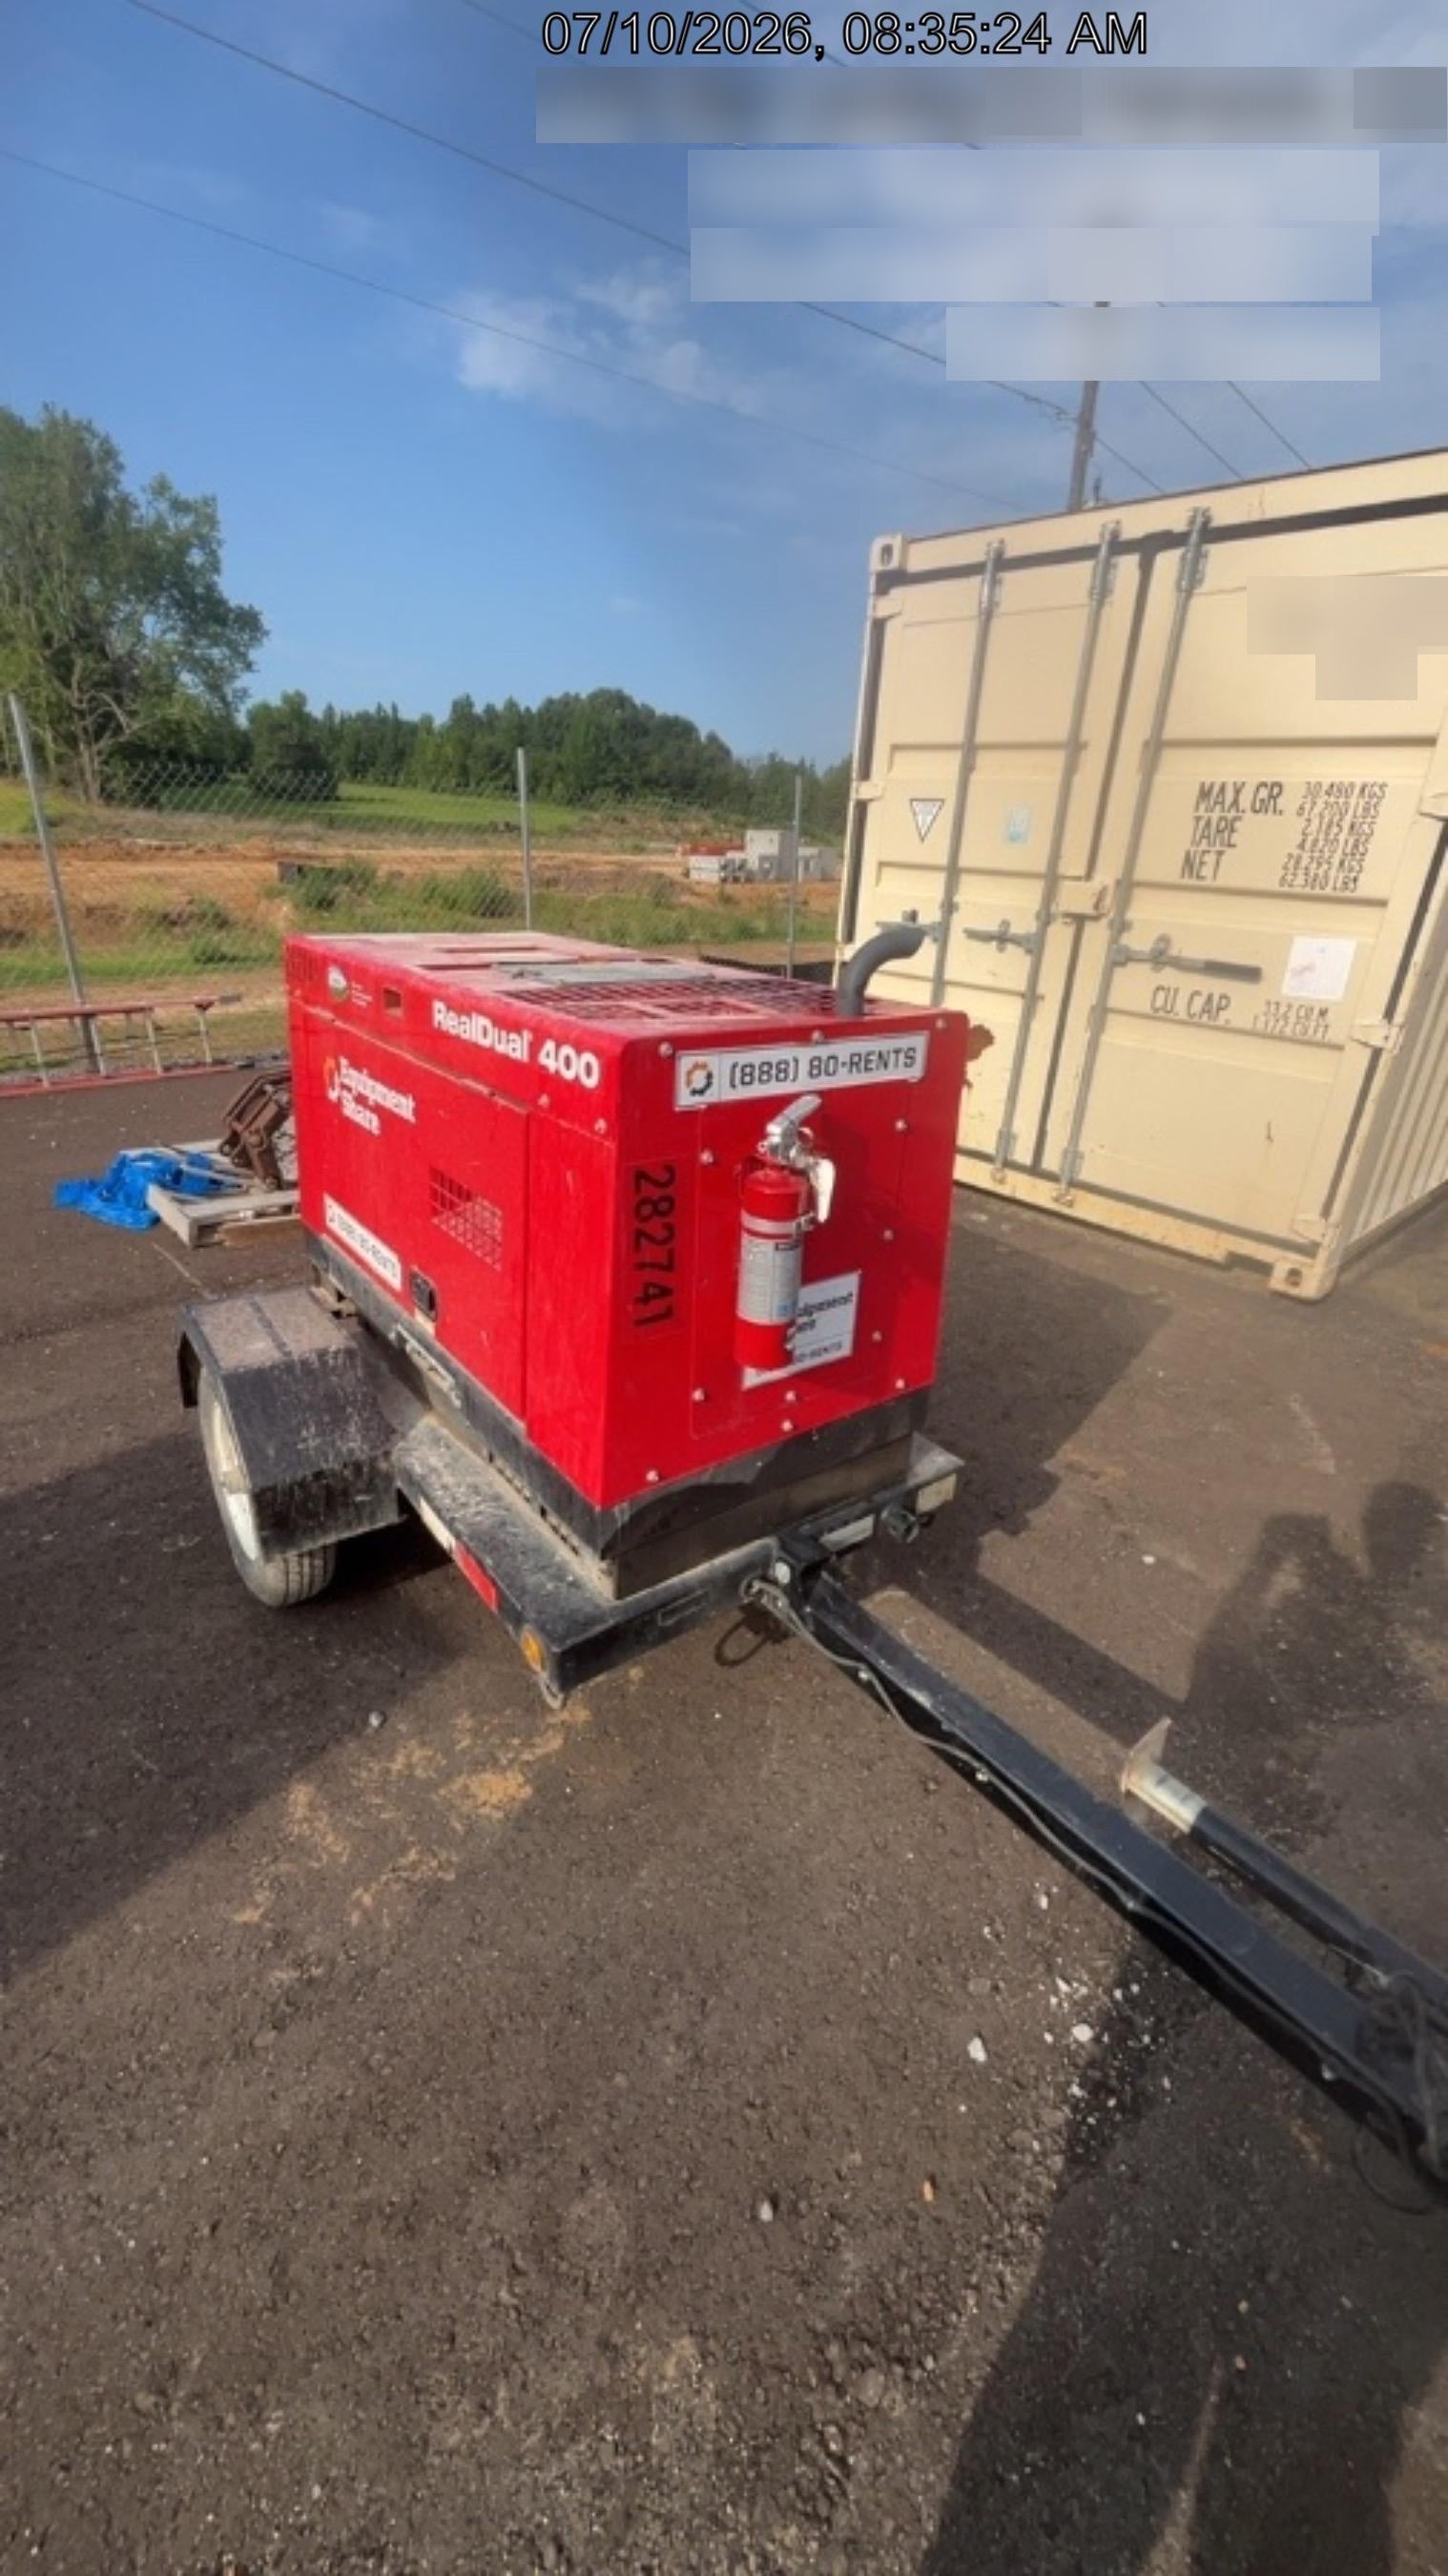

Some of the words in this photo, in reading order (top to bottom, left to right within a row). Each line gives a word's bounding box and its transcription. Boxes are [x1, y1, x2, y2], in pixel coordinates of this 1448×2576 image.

[1190, 815, 1243, 848] TARE
[1180, 848, 1226, 882] NET
[432, 999, 531, 1064] RealDual
[537, 1037, 600, 1090] 400
[729, 1055, 799, 1091] (888)
[808, 1046, 917, 1080] 80-RENTS
[633, 1162, 677, 1327] 282741
